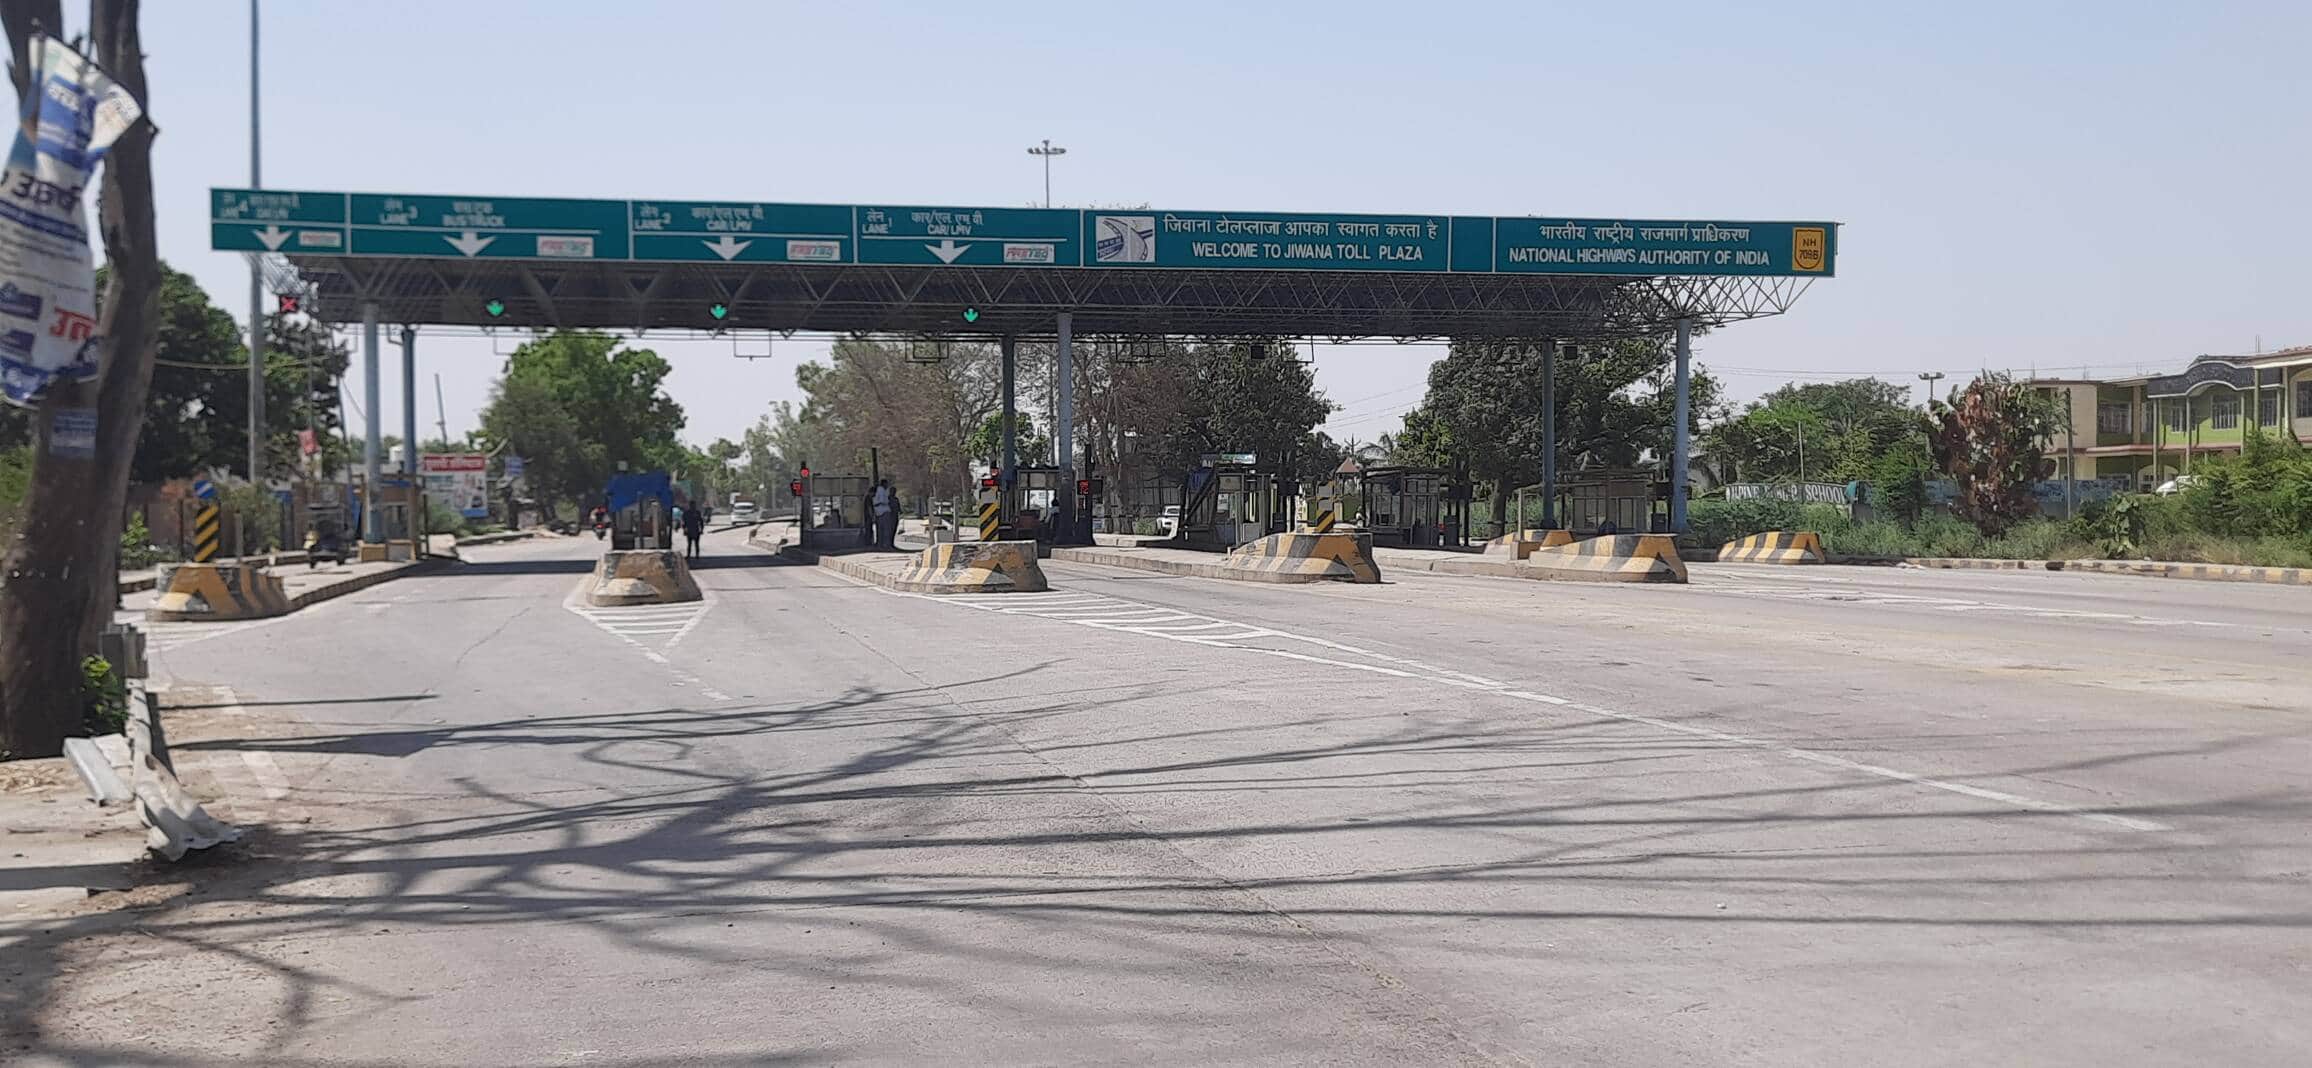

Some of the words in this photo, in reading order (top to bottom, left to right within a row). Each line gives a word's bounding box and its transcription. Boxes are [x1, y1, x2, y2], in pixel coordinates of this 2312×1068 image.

[867, 209, 884, 222] लेन
[634, 219, 664, 230] LANE
[862, 224, 888, 234] LANE
[1163, 214, 1210, 234] जिवाना
[1216, 215, 1281, 236] टोलप्लाजा
[1285, 222, 1329, 236] आपका
[1336, 222, 1380, 237] स्वागत
[1385, 223, 1420, 238] करता
[1426, 218, 1438, 240] है
[1540, 221, 1586, 240] भारतीय
[1592, 222, 1634, 244] राष्ट्रीय
[1640, 223, 1688, 242] राजमार्ग
[1803, 238, 1816, 246] NH
[1192, 242, 1258, 258] WELCOME
[1263, 244, 1281, 258] TO
[1284, 244, 1333, 260] JIWANA
[1336, 244, 1372, 260] TOLL
[1379, 246, 1423, 261] PLAZA
[1509, 248, 1575, 262] NATIONAL
[1576, 248, 1636, 264] HIGHWAYS
[1639, 249, 1714, 265] AUTHORITY
[1715, 250, 1731, 265] OF
[1736, 250, 1770, 266] INDIA
